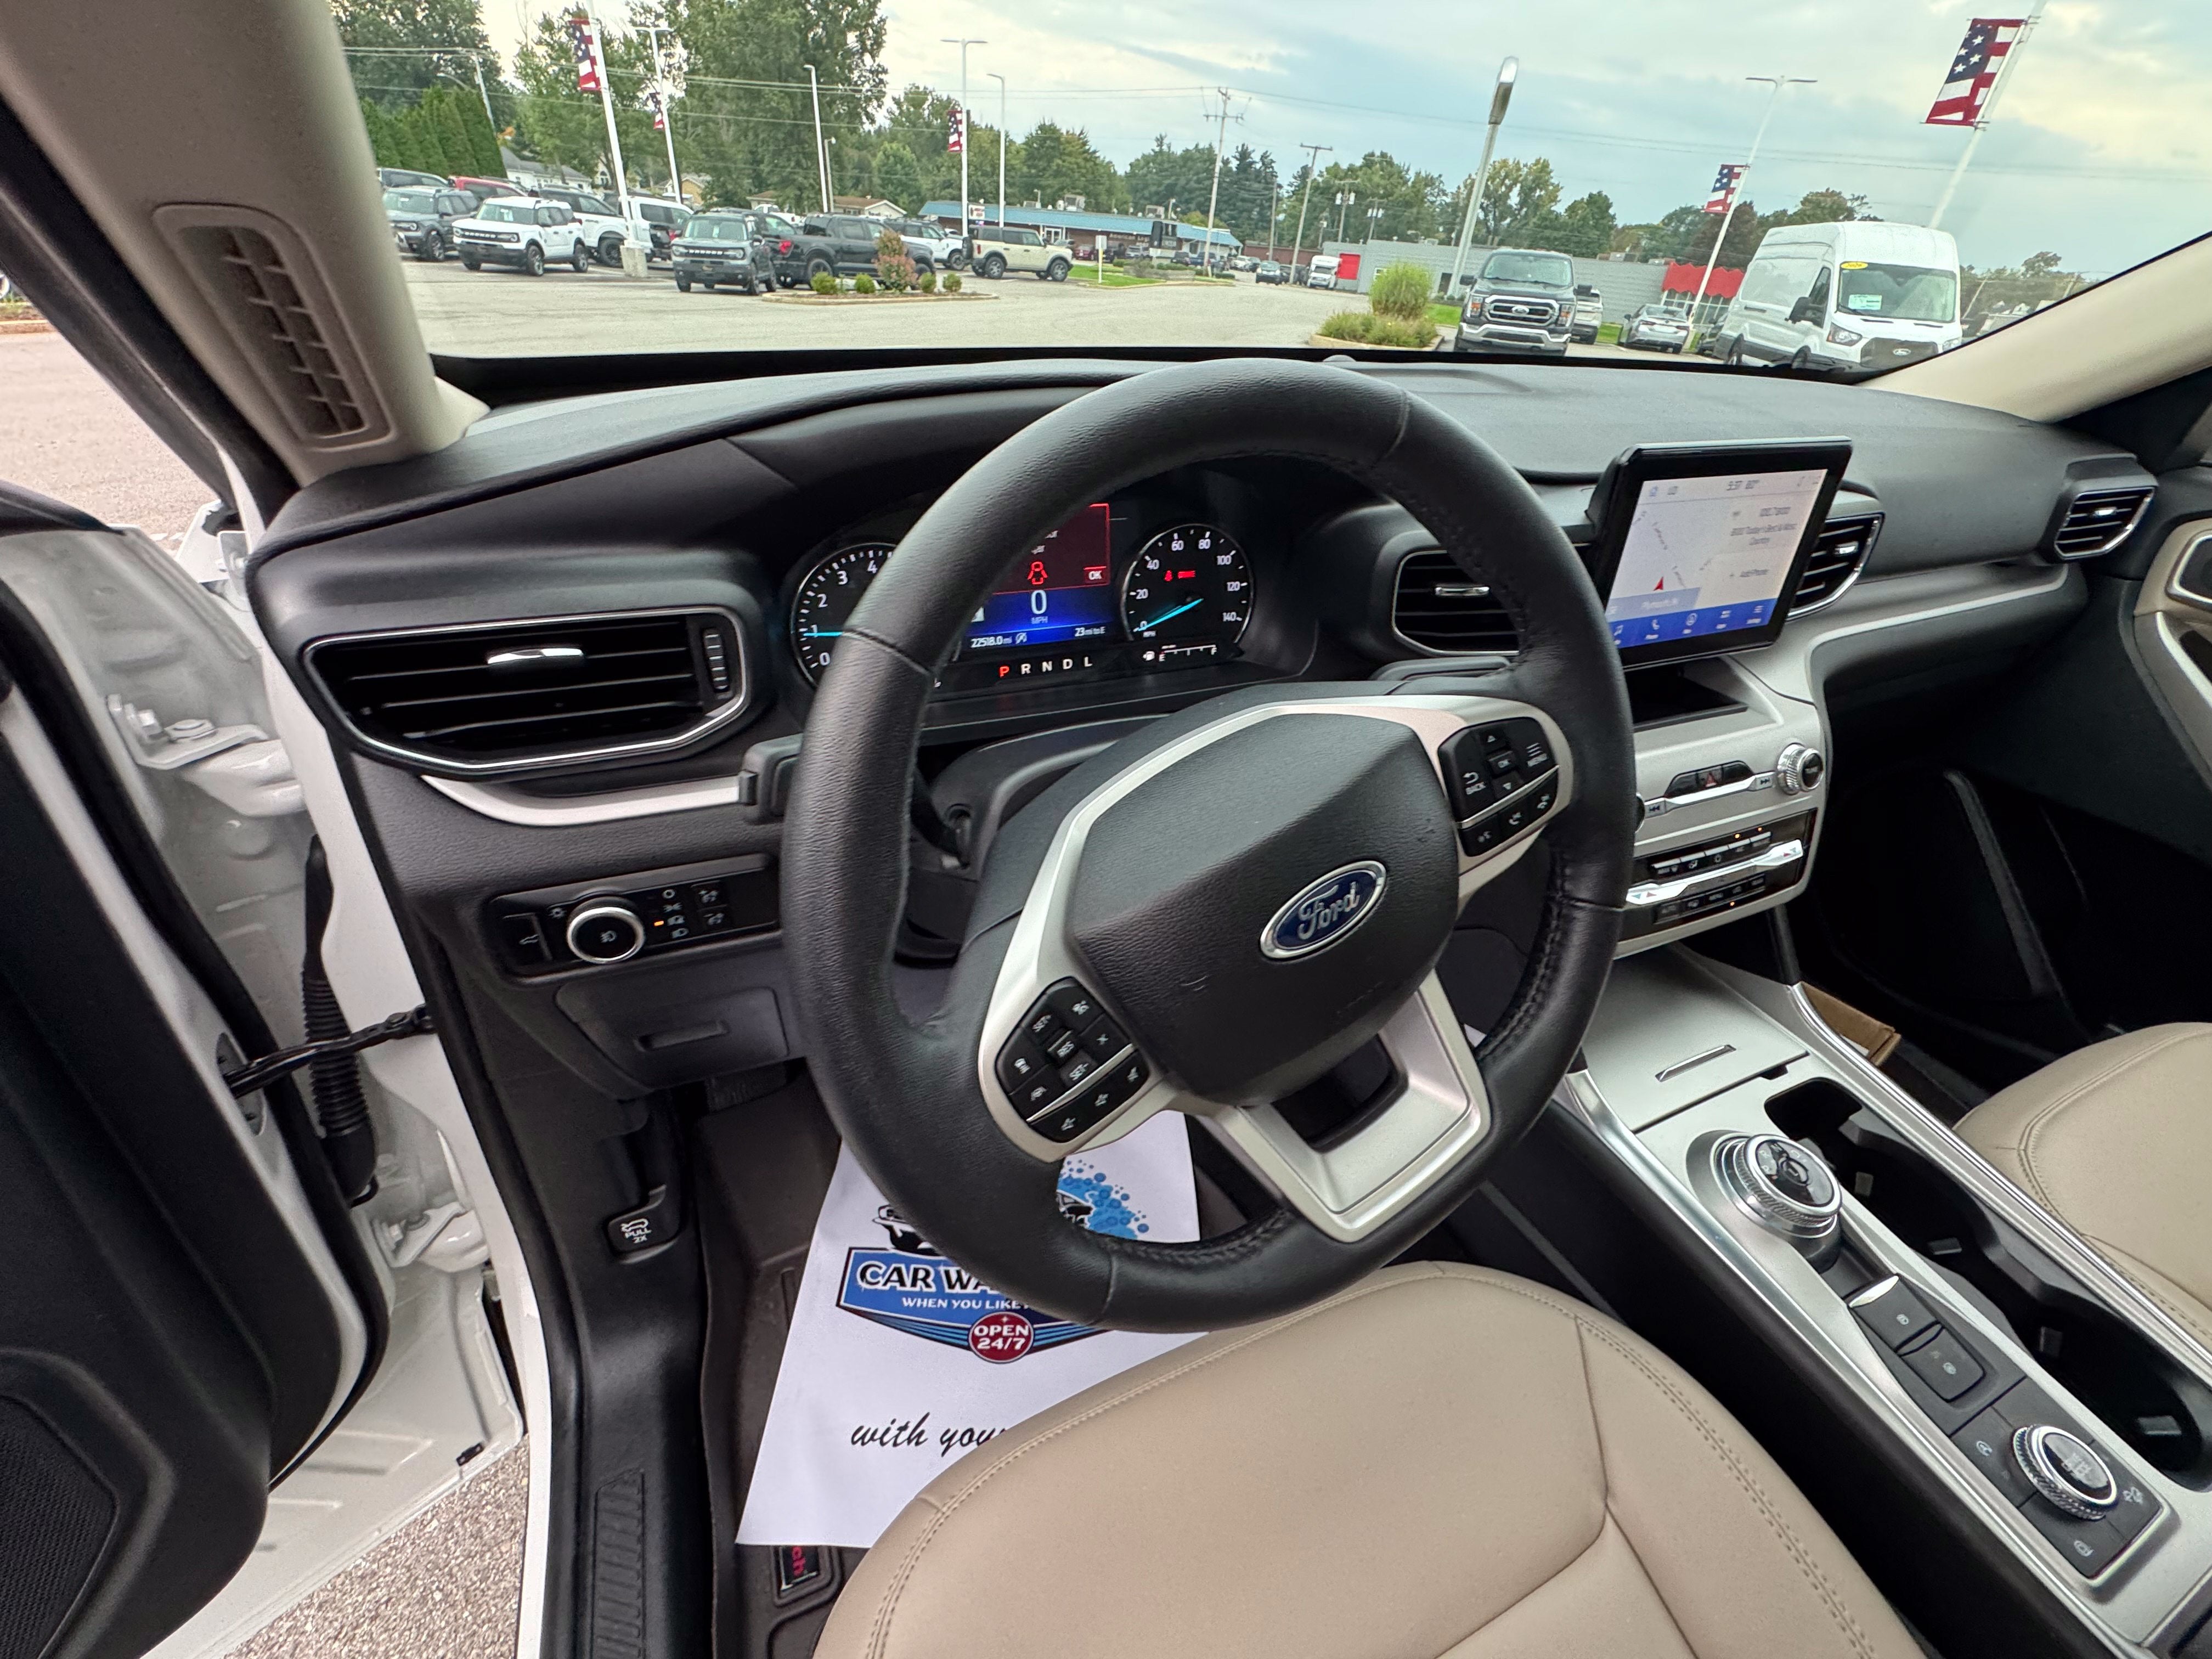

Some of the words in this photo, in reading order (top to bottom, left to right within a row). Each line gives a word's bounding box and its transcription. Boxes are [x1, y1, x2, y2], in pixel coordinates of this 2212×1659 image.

[1171, 540, 1184, 551] 60
[1198, 539, 1211, 549] 80
[1147, 559, 1159, 569] 40
[1217, 555, 1232, 565] 100
[866, 560, 878, 574] 4
[837, 571, 848, 585] 3
[1088, 571, 1102, 580] OK
[1227, 581, 1240, 591] 120
[1136, 589, 1148, 599] 20
[817, 594, 828, 608] 2
[1031, 590, 1047, 614] 0
[1222, 612, 1237, 622] 140
[810, 624, 818, 637] 1
[820, 652, 831, 666] 0
[1000, 665, 1009, 677] P
[1020, 663, 1032, 675] R
[1042, 661, 1053, 673] N
[1063, 658, 1073, 670] D
[1084, 656, 1093, 667] L
[1297, 881, 1361, 940] Ford
[625, 1228, 652, 1238] PULL
[857, 1261, 935, 1291] CAR
[902, 1297, 948, 1310] WHEN
[951, 1299, 982, 1310] YOU
[973, 1325, 1030, 1337] OPEN
[977, 1338, 1026, 1350] 24/7
[850, 1412, 930, 1448] with
[939, 1427, 1006, 1458] you
